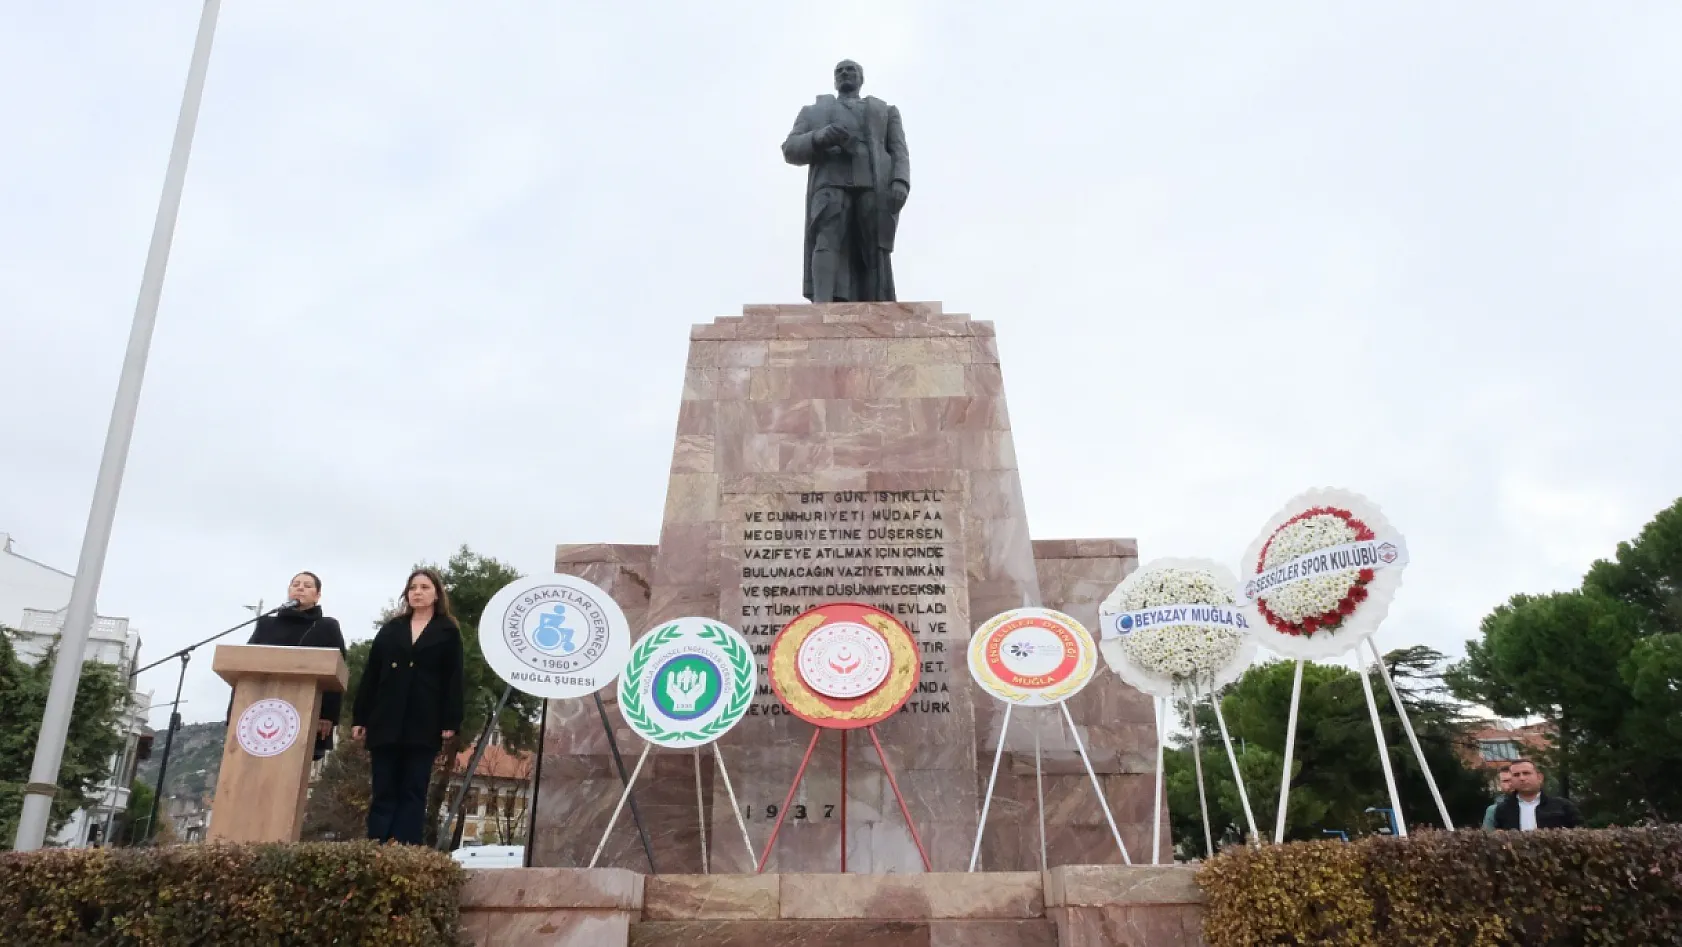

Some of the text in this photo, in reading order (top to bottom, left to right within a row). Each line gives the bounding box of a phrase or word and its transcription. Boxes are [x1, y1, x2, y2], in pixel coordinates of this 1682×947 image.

[745, 511, 762, 523] VE
[1301, 554, 1329, 577] SPOR
[1330, 542, 1378, 571] KULÜBÜ
[742, 585, 759, 597] VE
[524, 588, 592, 611] SAKATLAR
[742, 605, 760, 617] EY
[1134, 608, 1187, 628] BEYAZAY
[1191, 606, 1233, 626] MUĞLA
[929, 622, 947, 633] VE
[542, 658, 570, 670] 1960
[510, 670, 596, 688] MUĞLA ŞUBESİ
